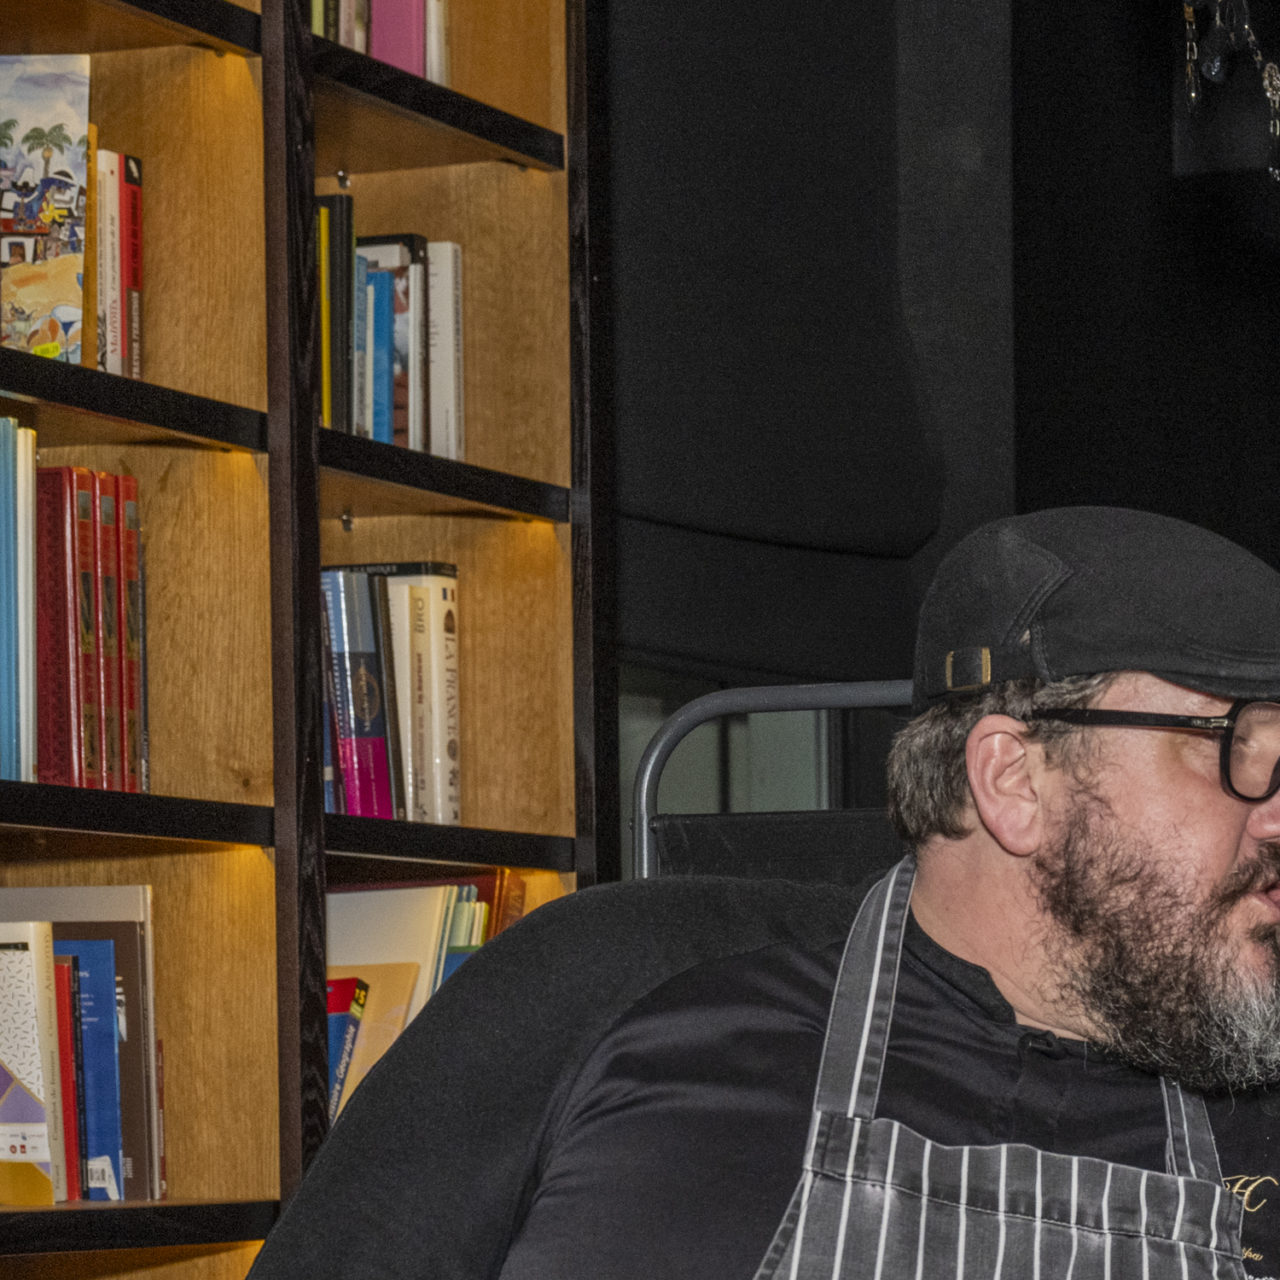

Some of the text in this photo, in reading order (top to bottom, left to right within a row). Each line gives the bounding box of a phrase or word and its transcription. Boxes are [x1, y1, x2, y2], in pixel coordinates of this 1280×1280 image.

[445, 636, 457, 737] LA FRANCE
[336, 1024, 357, 1079] Géographie
